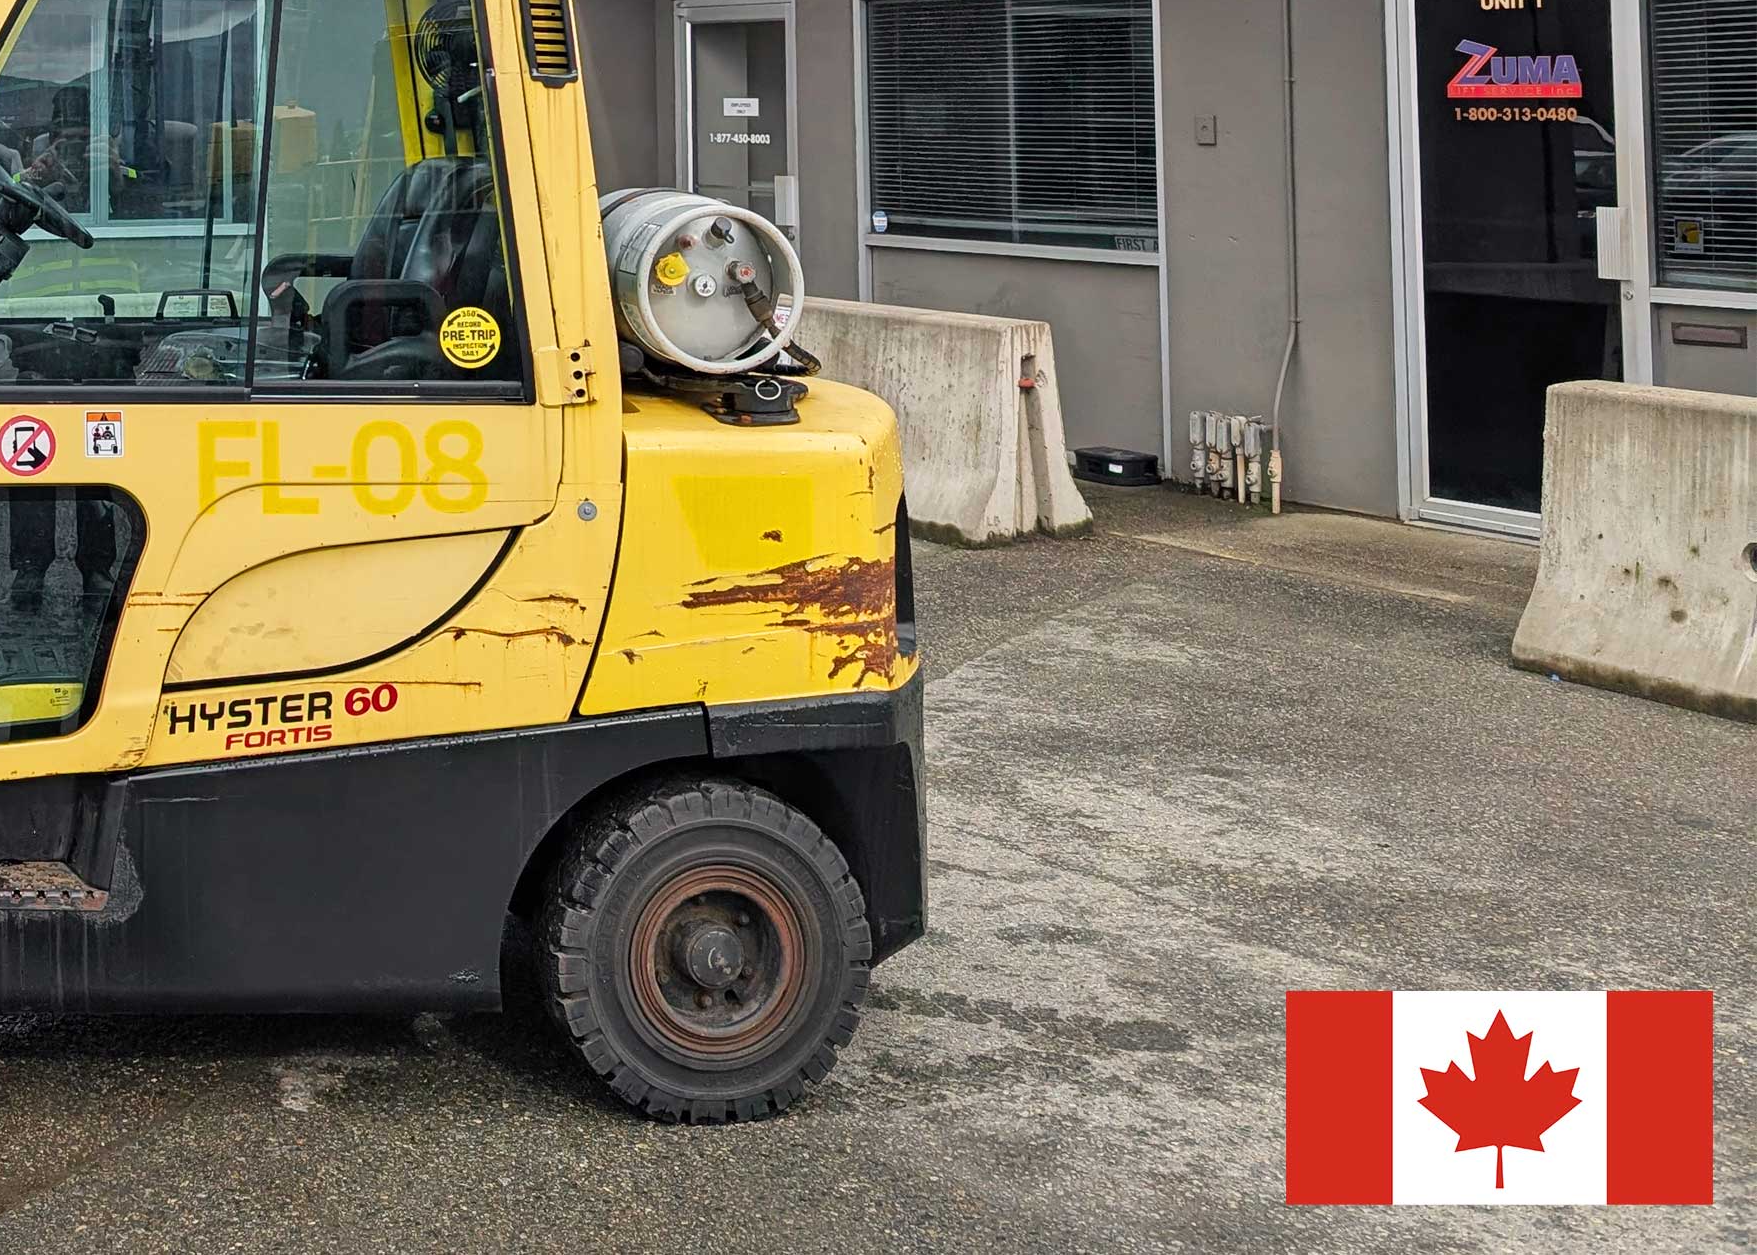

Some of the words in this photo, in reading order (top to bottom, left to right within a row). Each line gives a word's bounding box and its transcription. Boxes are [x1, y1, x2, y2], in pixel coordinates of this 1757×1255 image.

[1449, 39, 1582, 86] ZUMA
[1485, 87, 1543, 96] SERVICE
[1454, 107, 1577, 122] 1-800-313-0480
[709, 132, 770, 144] 1-877-450-8003
[1116, 237, 1146, 250] FIRST
[442, 329, 497, 342] PRE-TRIP
[453, 342, 488, 350] INSPECTION
[197, 419, 490, 515] FL-08
[168, 690, 334, 735] HYSTER
[344, 682, 398, 716] 60
[225, 724, 333, 750] FORTIS
